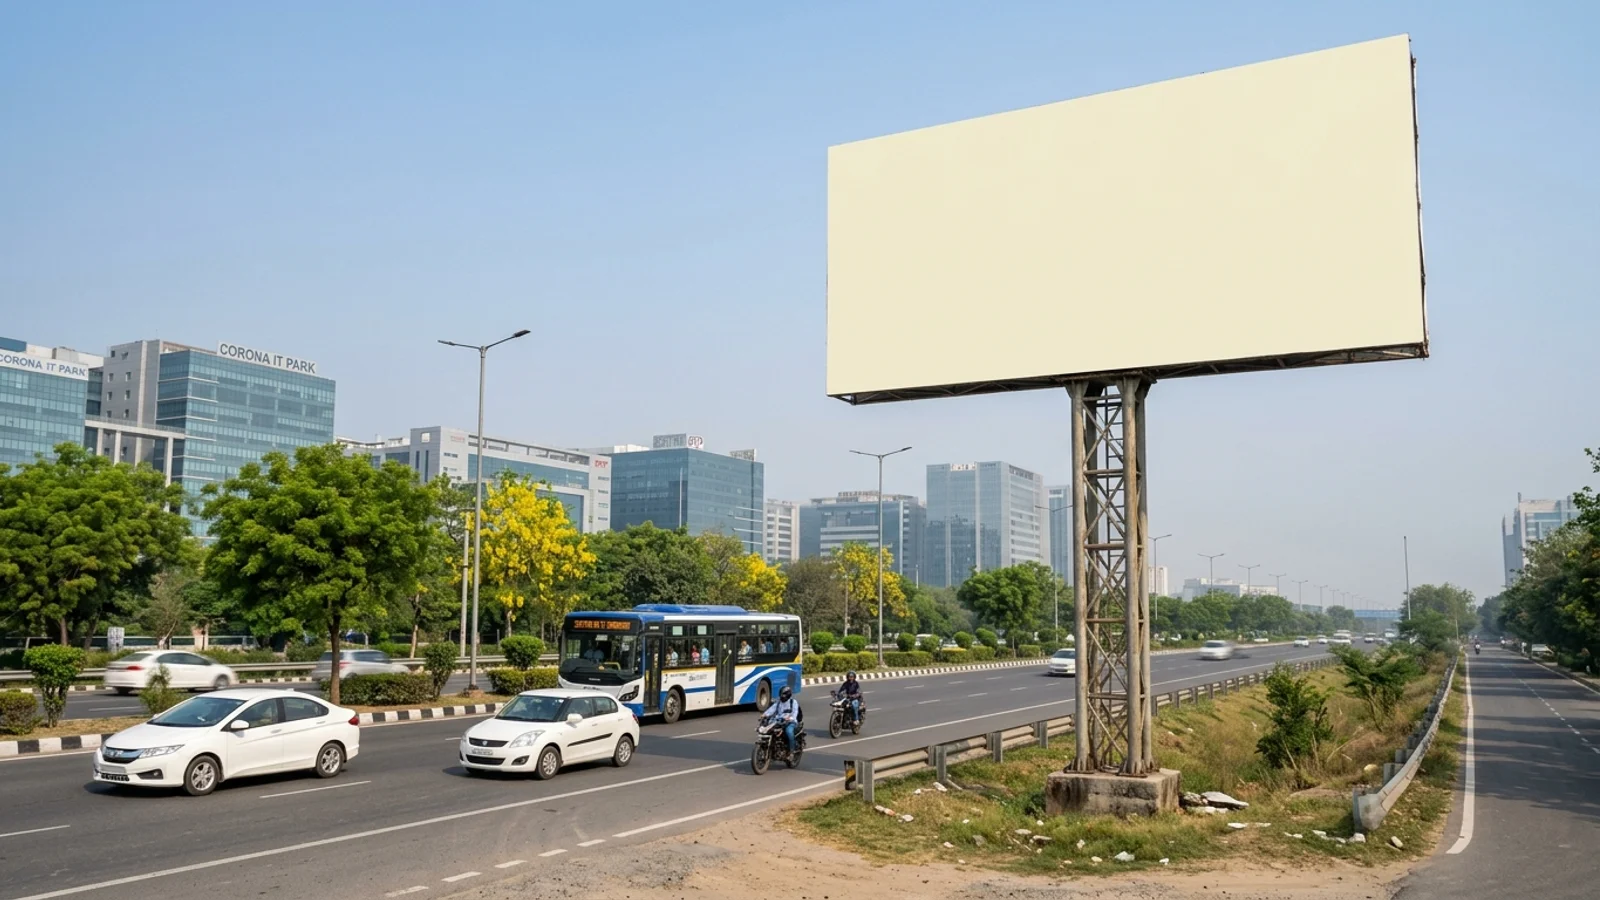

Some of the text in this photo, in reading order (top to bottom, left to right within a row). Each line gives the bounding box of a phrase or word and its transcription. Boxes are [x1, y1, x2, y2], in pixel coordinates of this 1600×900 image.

[46, 362, 57, 372] IT
[58, 364, 86, 377] PARK
[219, 343, 316, 374] CORONA IT PARK
